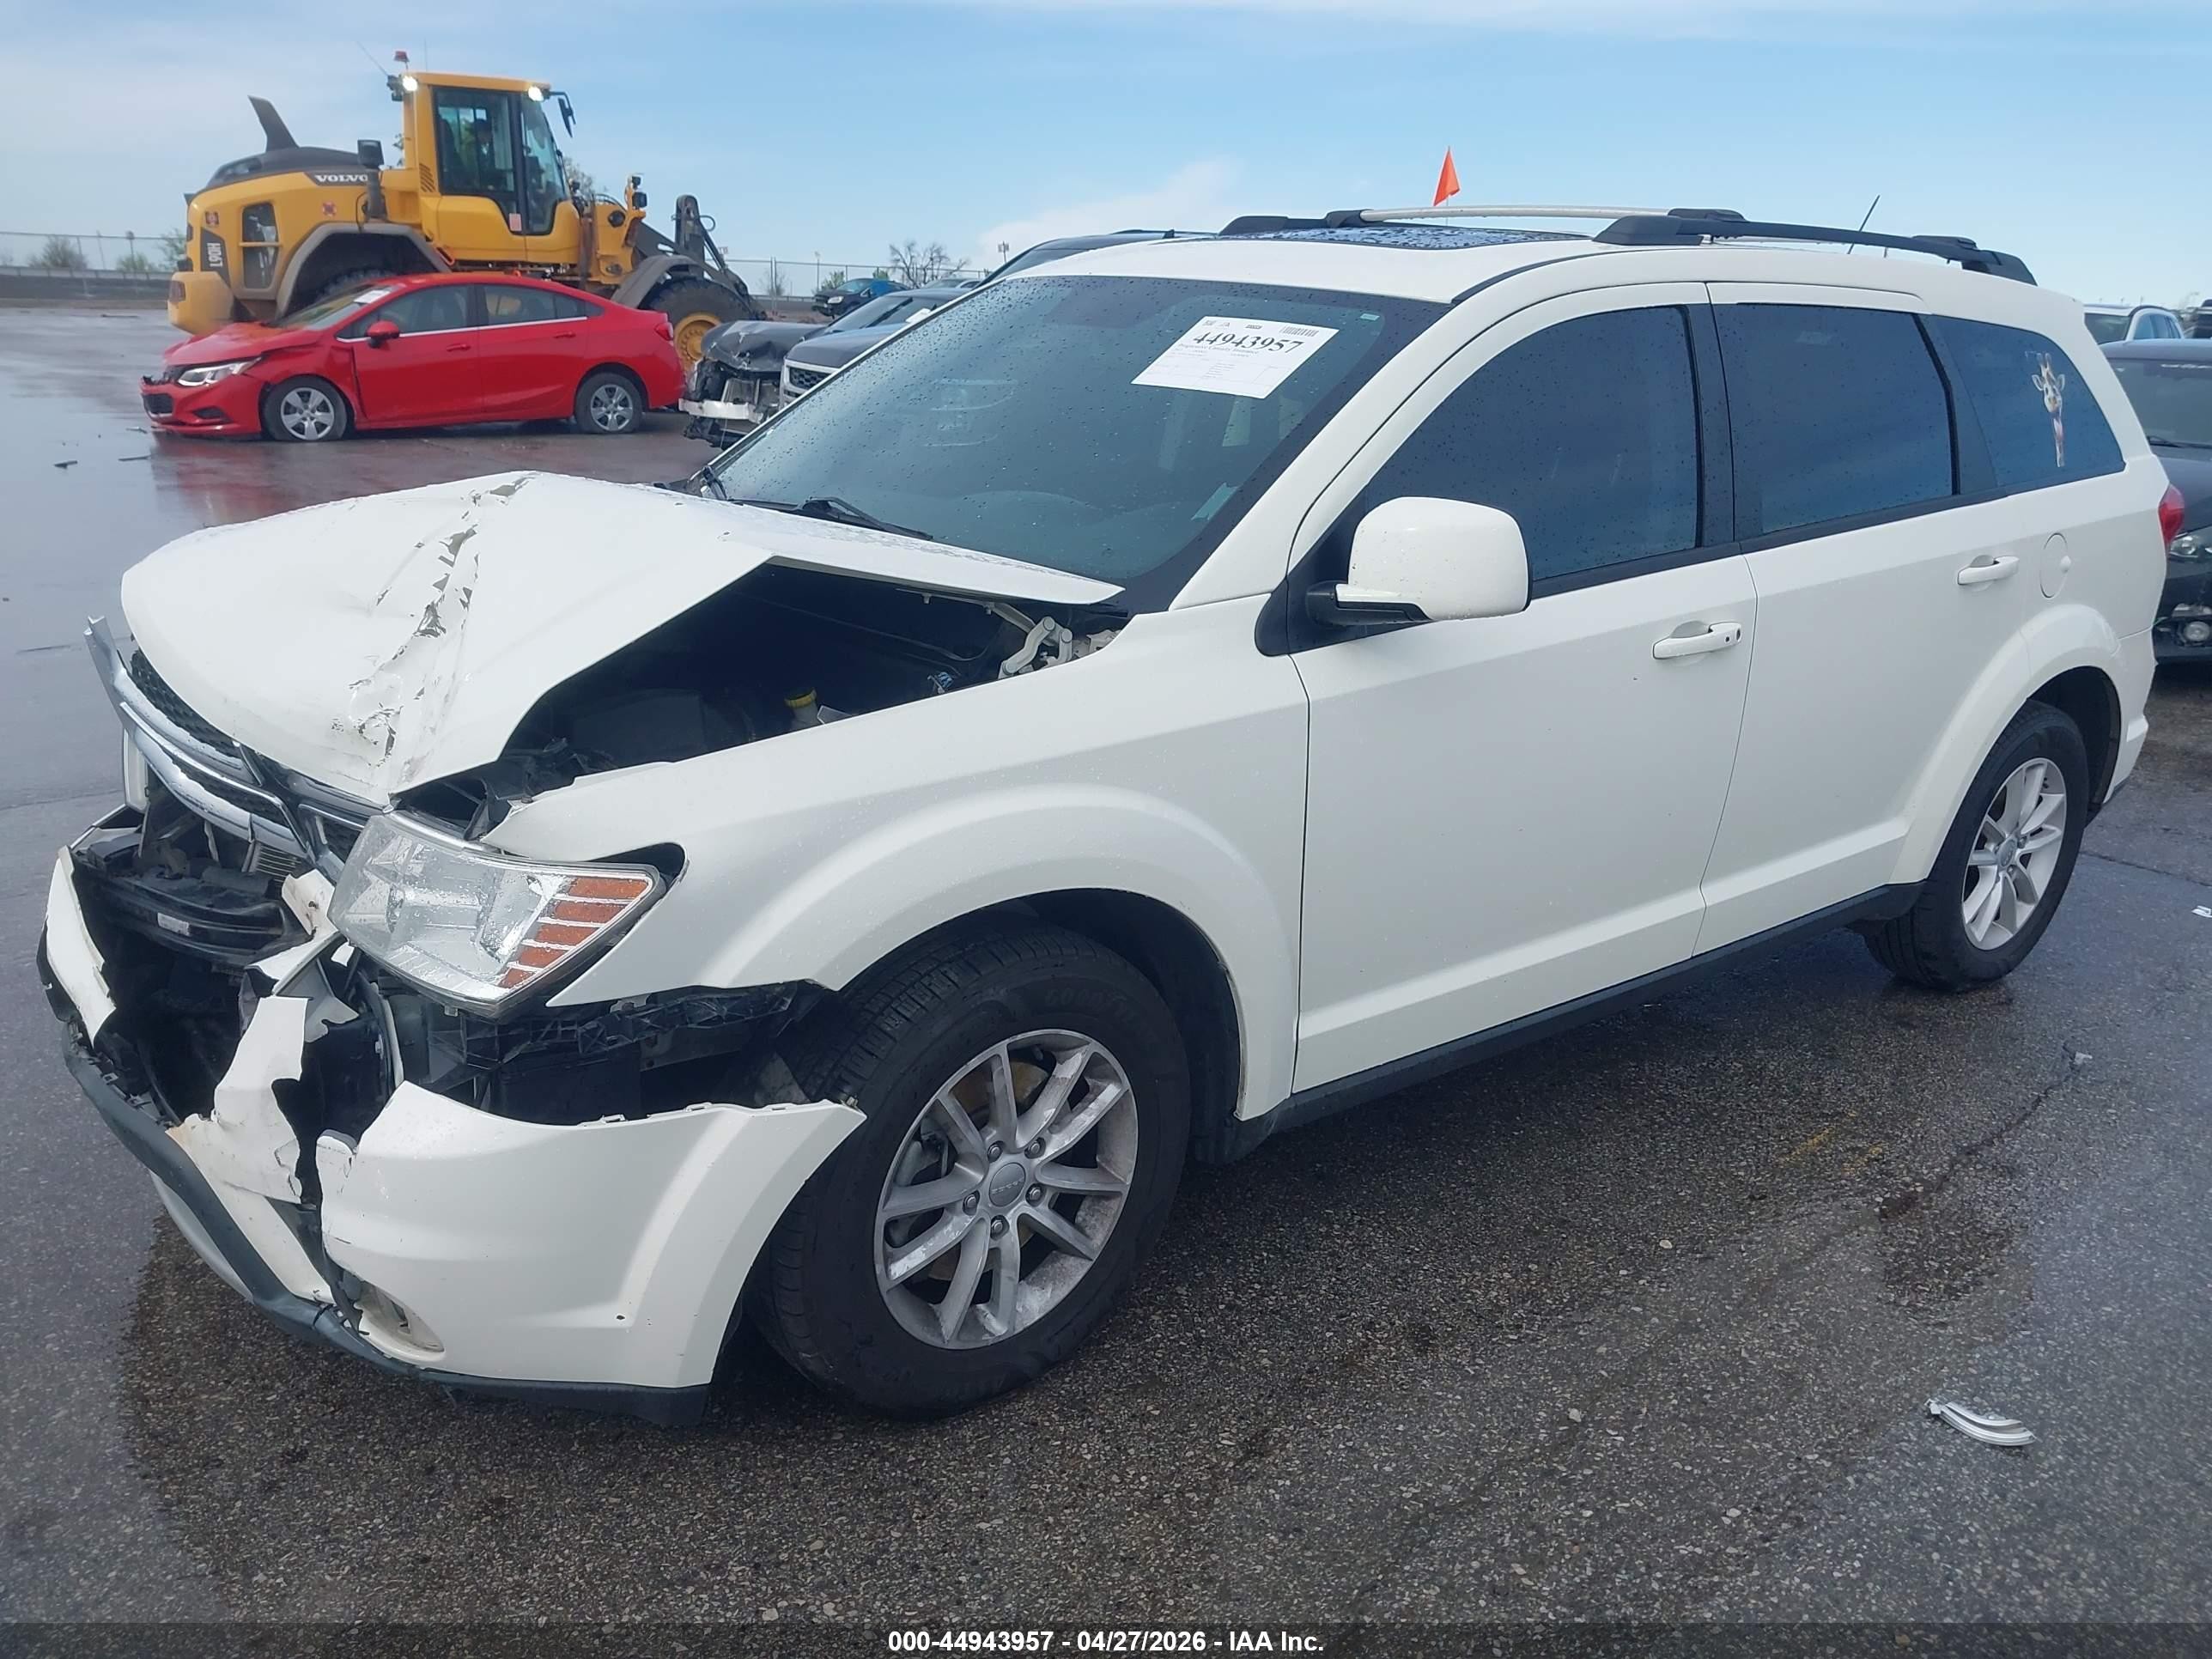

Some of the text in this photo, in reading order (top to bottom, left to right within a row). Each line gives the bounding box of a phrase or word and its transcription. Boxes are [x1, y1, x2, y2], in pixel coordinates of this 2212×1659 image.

[314, 174, 368, 183] VOLVO
[206, 242, 223, 268] L90H
[1193, 331, 1305, 354] 44943957
